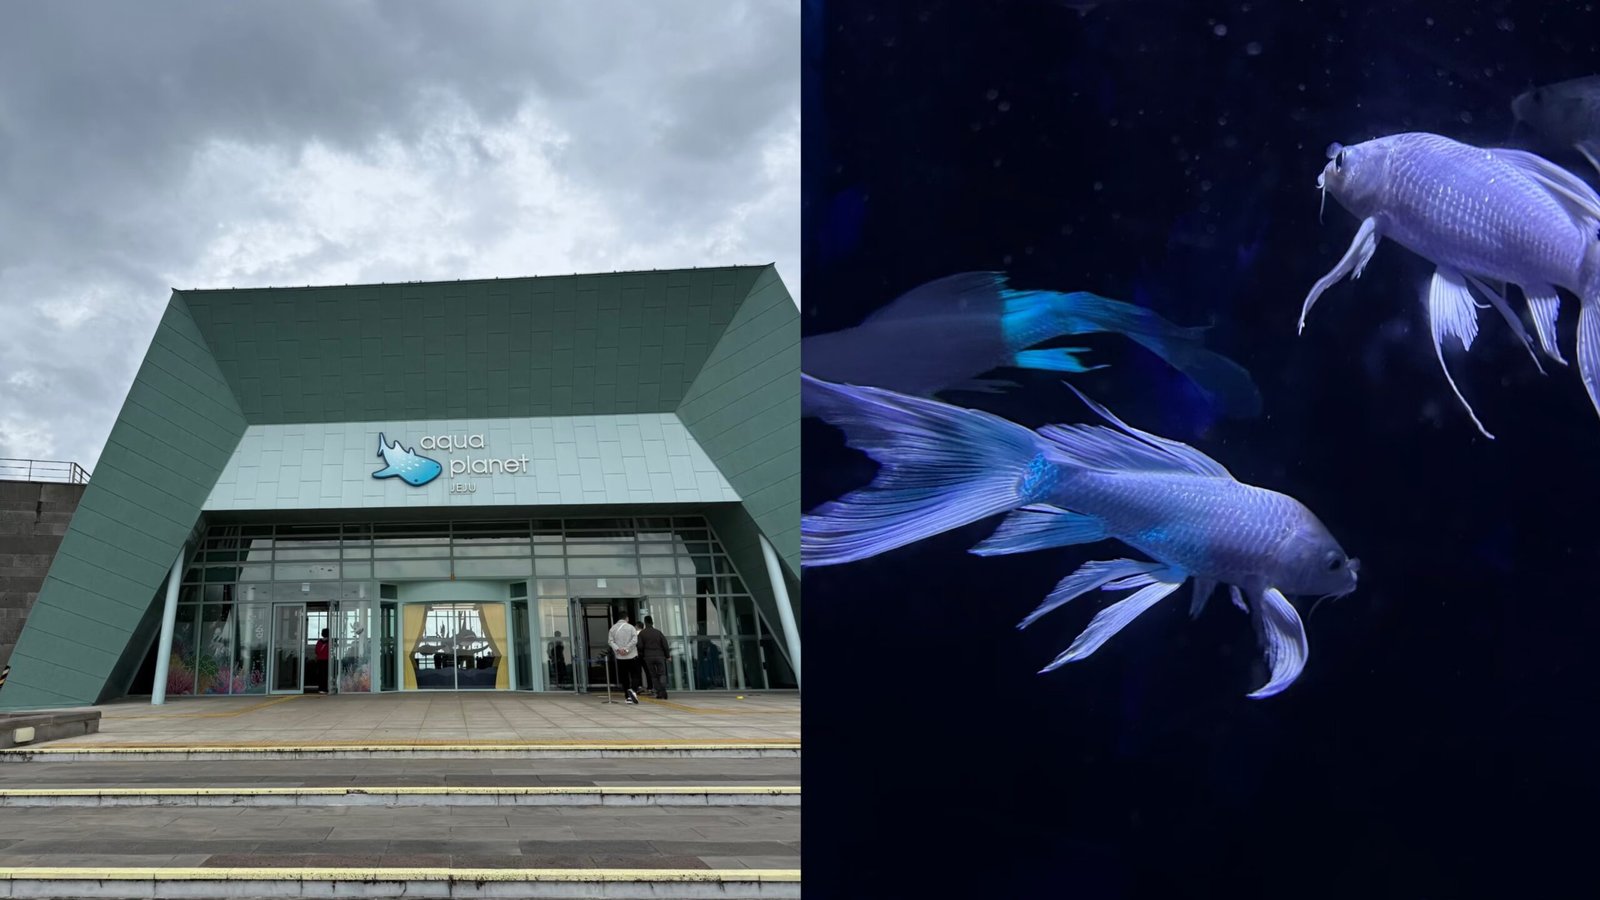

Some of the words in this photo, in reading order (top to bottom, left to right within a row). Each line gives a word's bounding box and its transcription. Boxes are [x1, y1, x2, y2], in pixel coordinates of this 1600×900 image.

[420, 433, 485, 452] aqua
[449, 453, 529, 478] planet
[450, 482, 477, 493] JEJU
